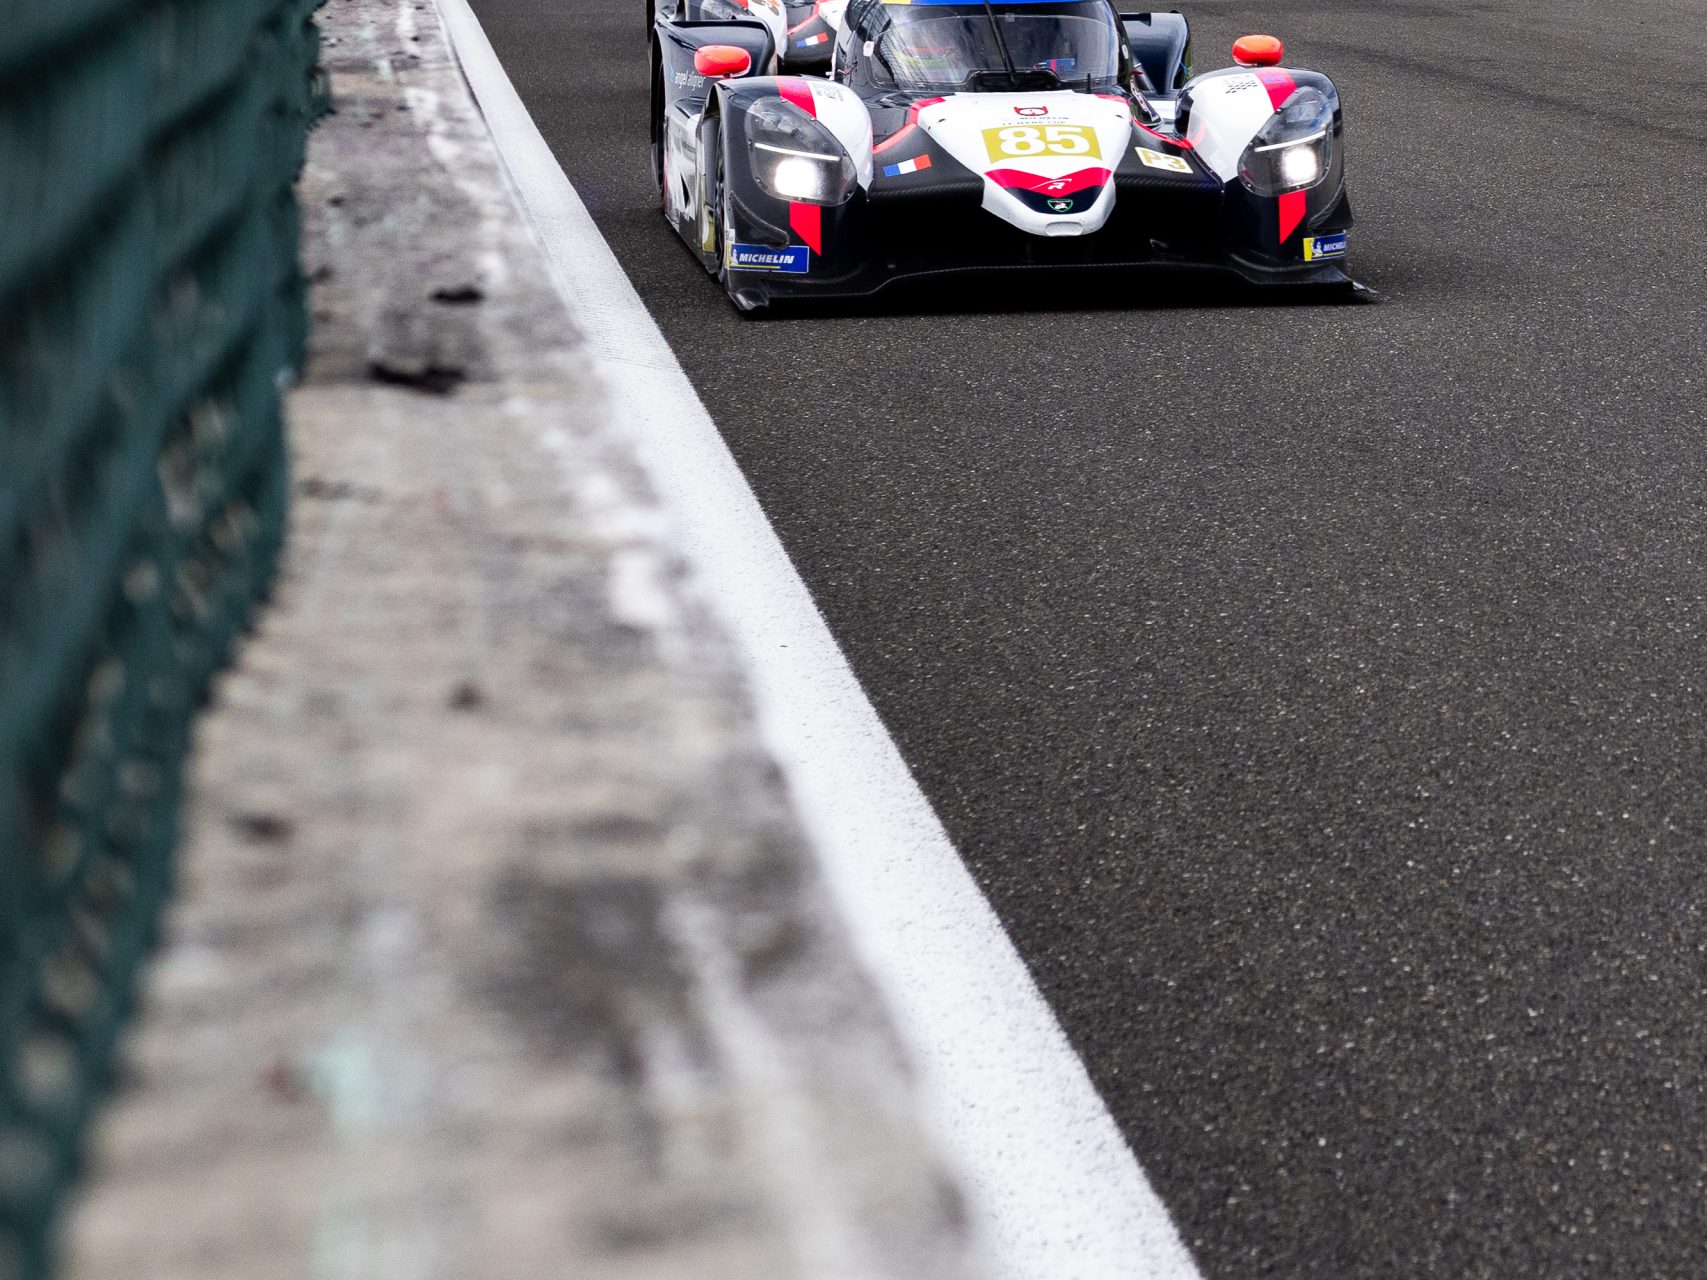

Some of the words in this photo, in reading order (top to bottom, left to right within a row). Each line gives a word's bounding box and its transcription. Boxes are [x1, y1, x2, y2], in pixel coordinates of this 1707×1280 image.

[998, 126, 1090, 155] 85
[1141, 149, 1185, 170] P3
[739, 254, 795, 264] MICHELIN
